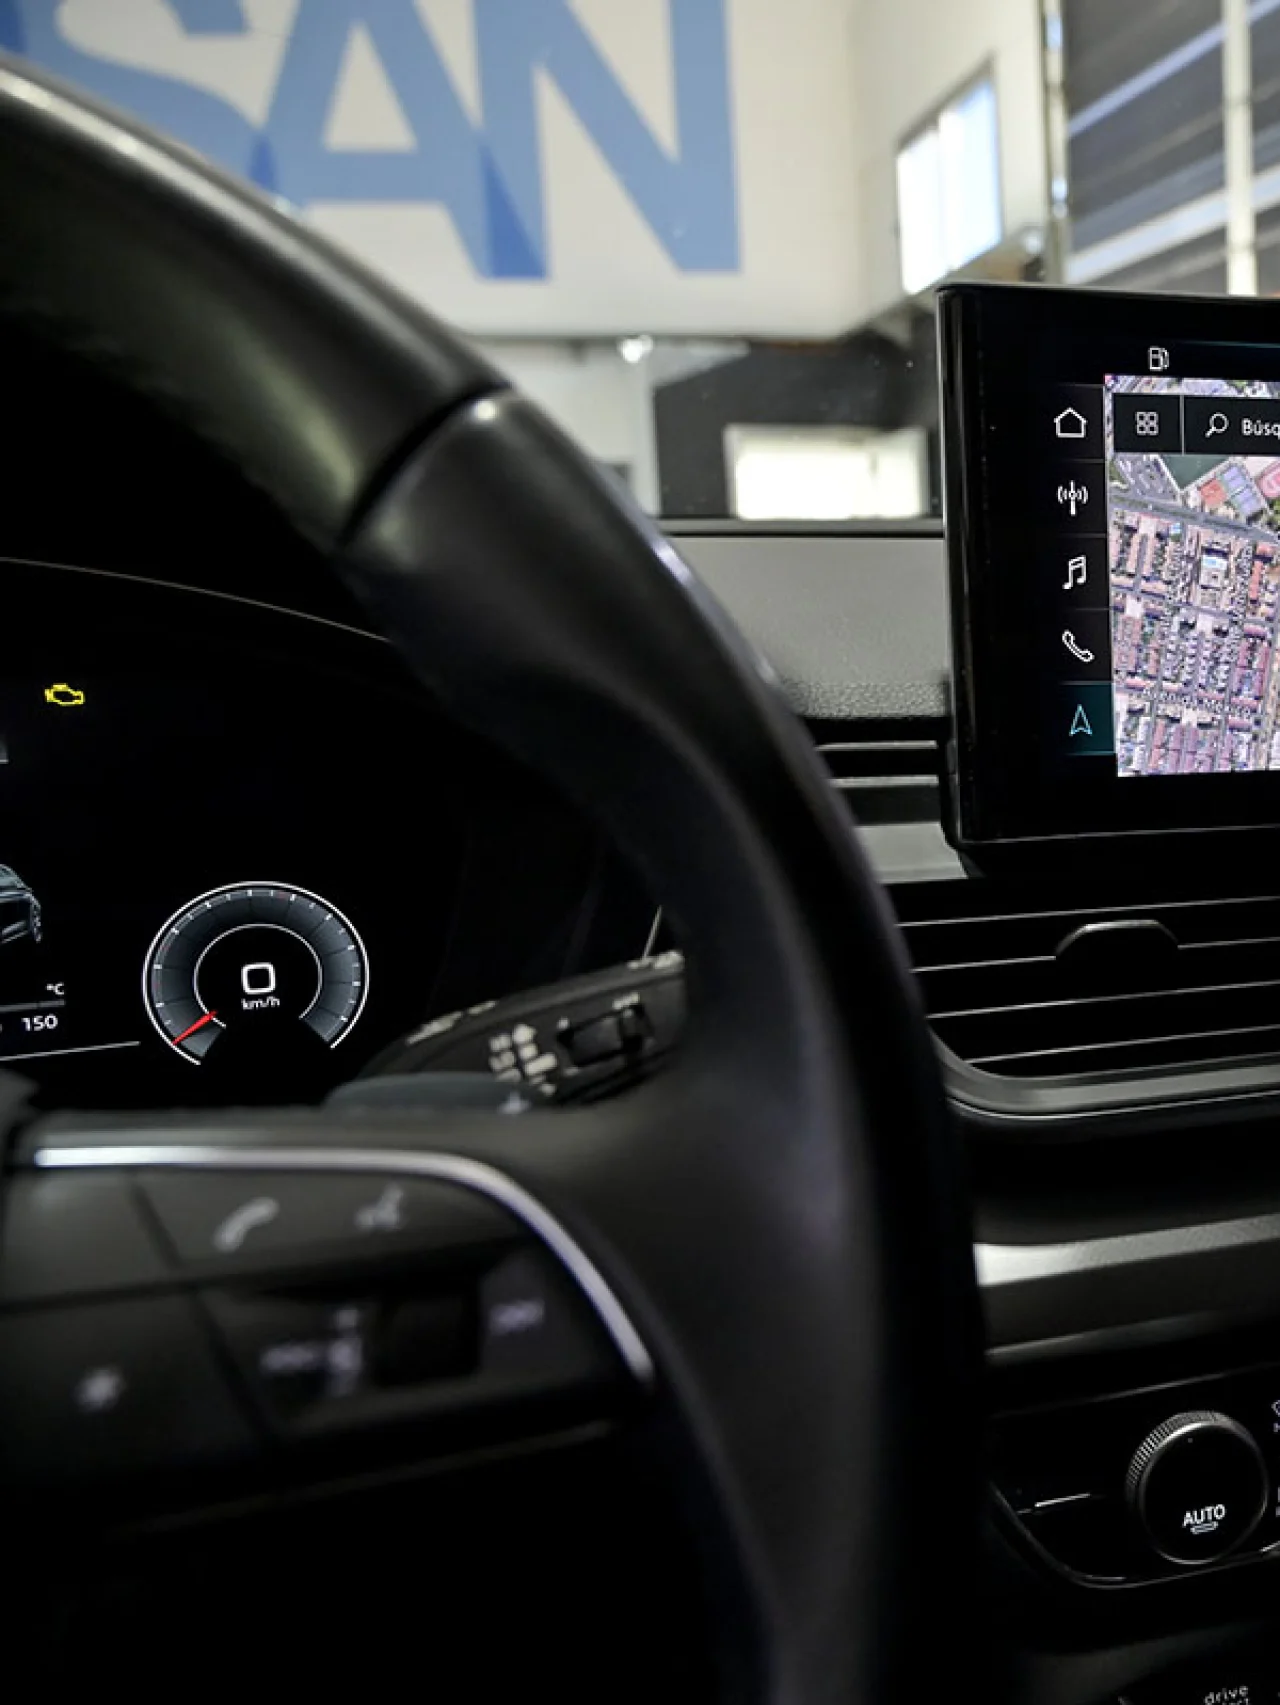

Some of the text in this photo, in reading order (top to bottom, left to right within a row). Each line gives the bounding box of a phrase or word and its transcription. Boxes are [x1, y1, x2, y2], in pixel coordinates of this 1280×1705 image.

[240, 961, 277, 996] 0
[45, 982, 66, 996] °C
[240, 996, 281, 1011] km/h
[21, 1013, 60, 1033] 150
[1182, 1503, 1227, 1528] AUTO
[1204, 1686, 1249, 1705] drive
